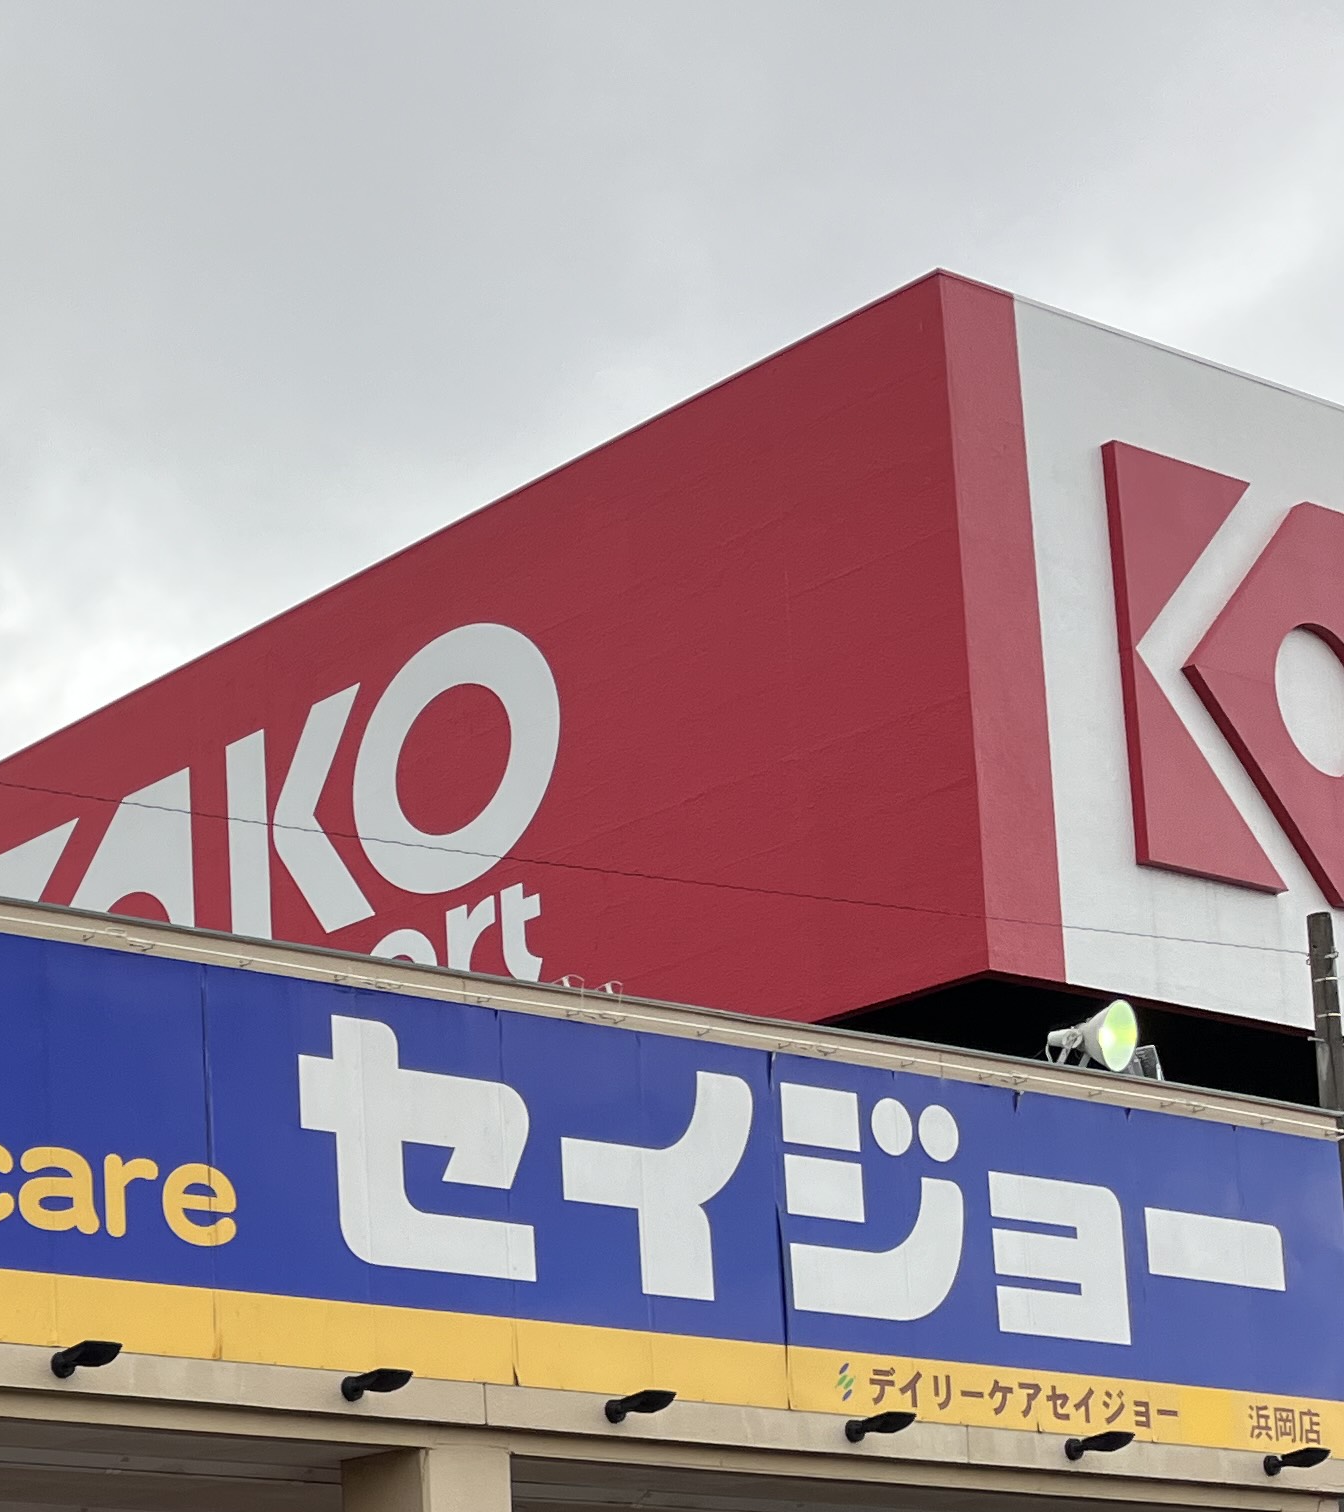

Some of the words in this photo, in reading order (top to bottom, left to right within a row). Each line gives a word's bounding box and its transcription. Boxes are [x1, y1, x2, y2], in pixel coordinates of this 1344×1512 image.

[298, 1014, 1286, 1346] セイジョー
[869, 1366, 1179, 1429] デイリーケアセイジョー
[1247, 1404, 1321, 1446] 浜岡店
